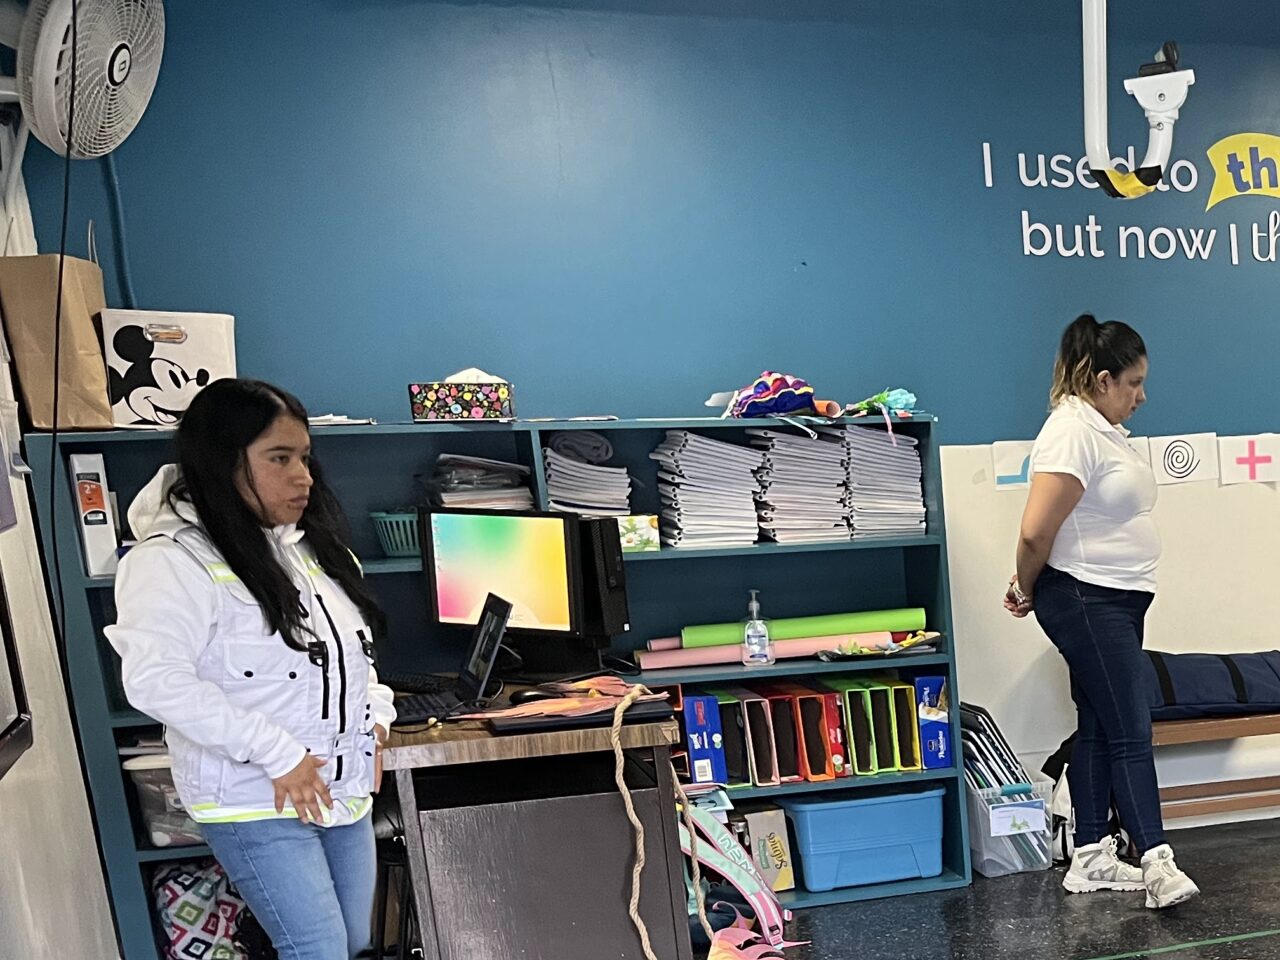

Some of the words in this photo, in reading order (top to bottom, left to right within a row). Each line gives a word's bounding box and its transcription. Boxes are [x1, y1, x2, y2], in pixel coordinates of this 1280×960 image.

[982, 142, 993, 188] I
[1021, 210, 1105, 258] but
[1119, 226, 1217, 260] now
[1229, 223, 1239, 265] I
